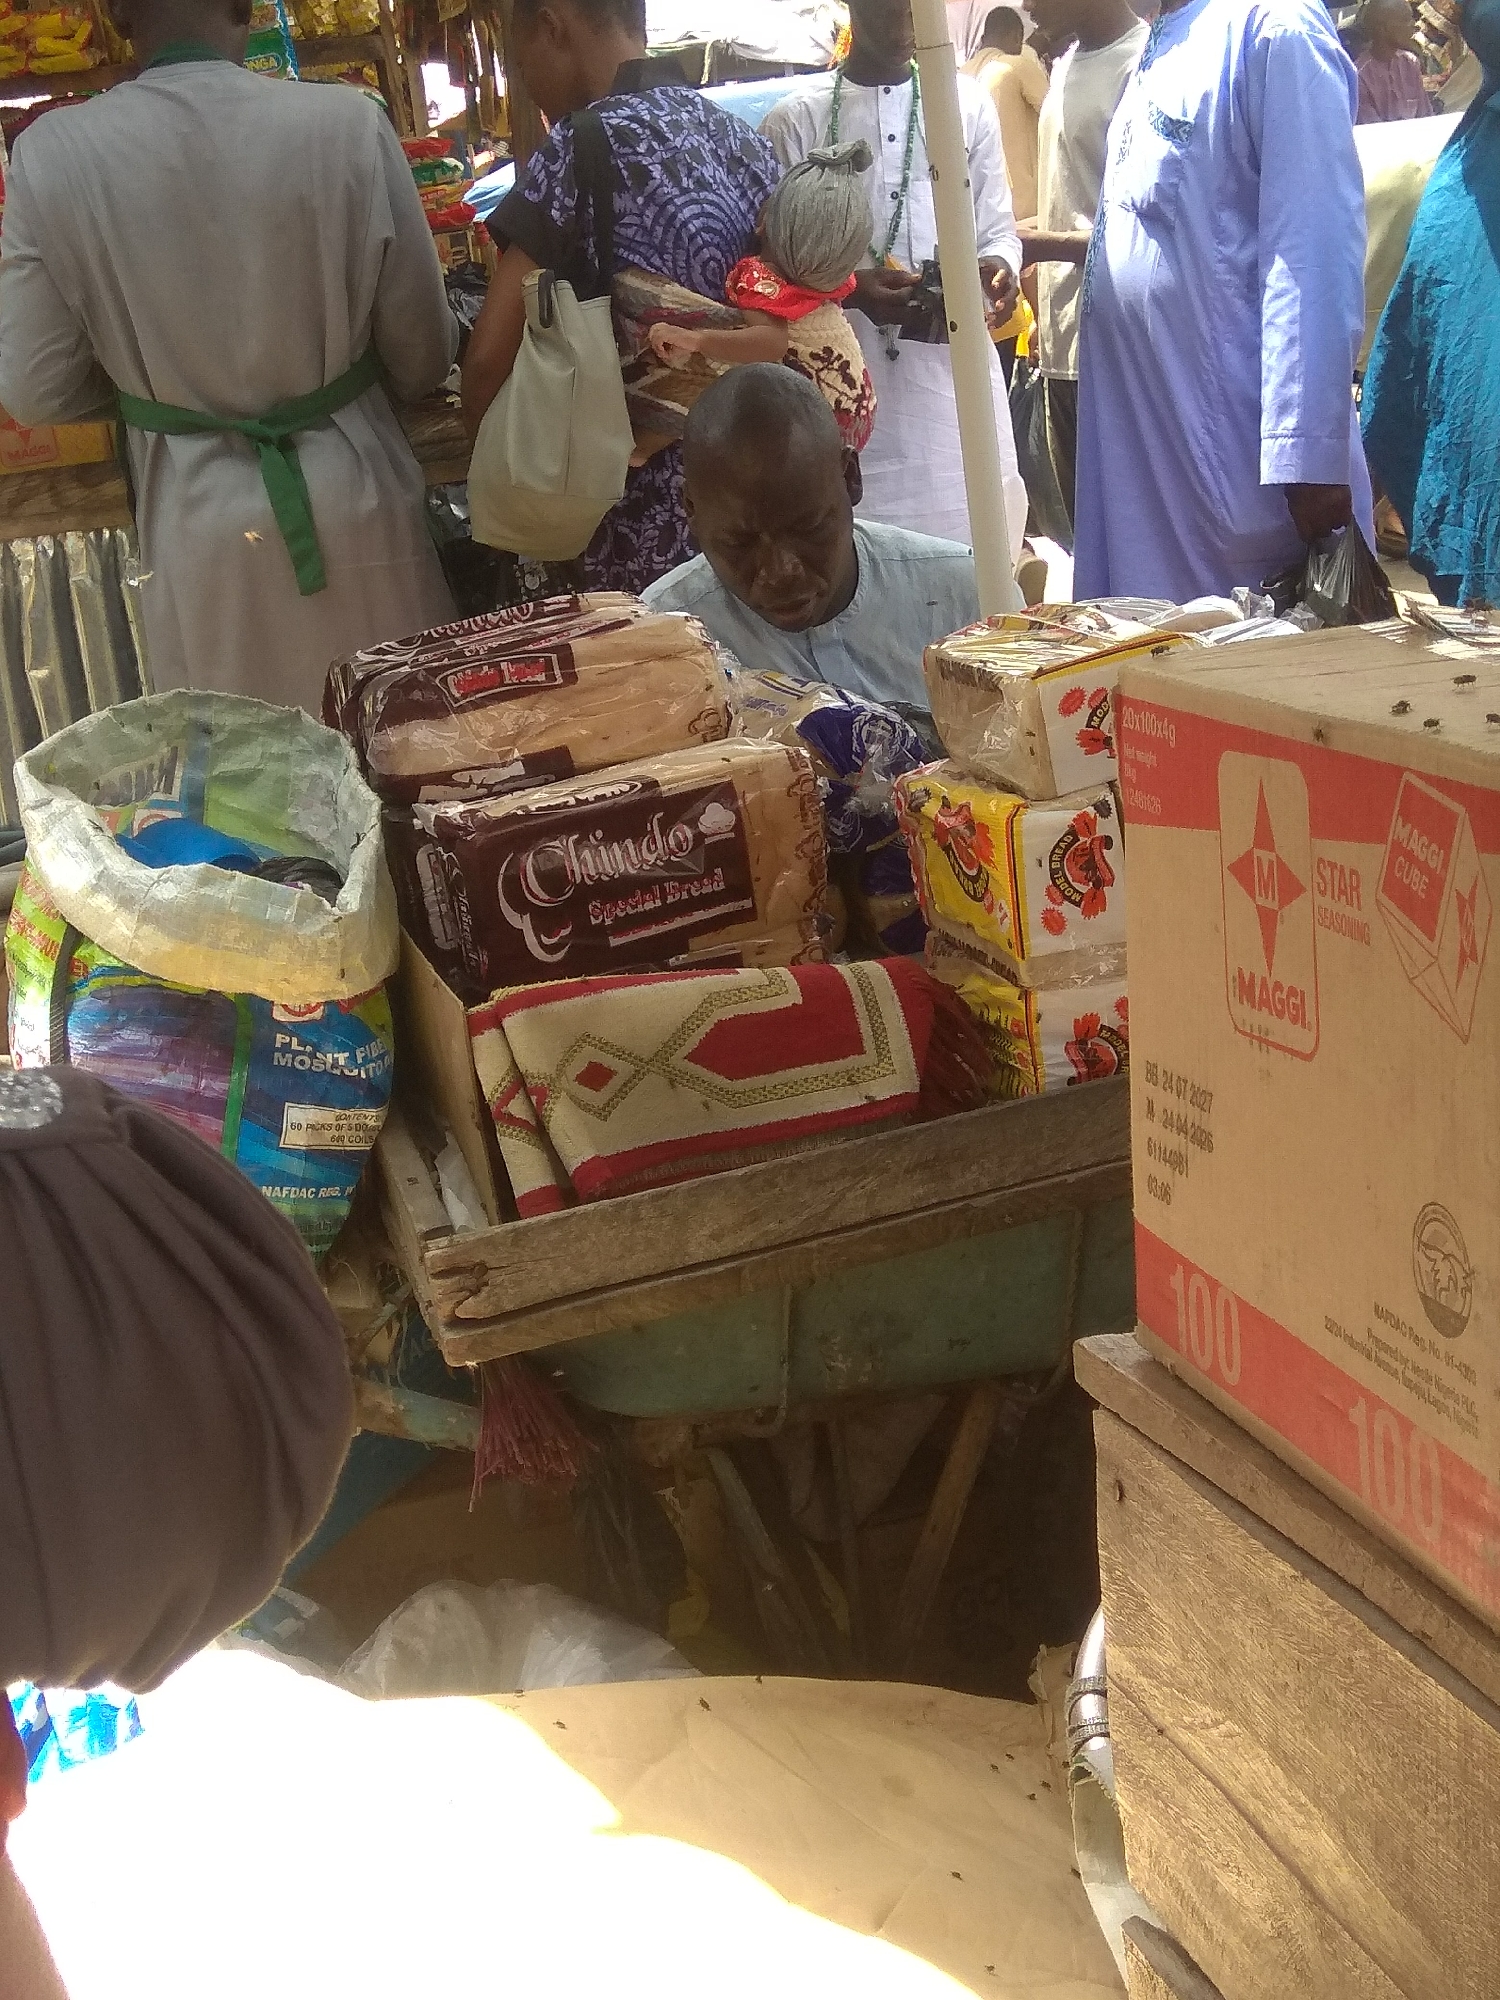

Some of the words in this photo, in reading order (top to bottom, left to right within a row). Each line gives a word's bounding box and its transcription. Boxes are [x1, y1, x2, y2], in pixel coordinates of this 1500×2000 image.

[1122, 705, 1176, 748] 20x100x4g
[519, 811, 694, 907] Chindo
[1051, 834, 1073, 869] BREAD
[1394, 815, 1446, 875] MAGGI
[588, 879, 663, 927] Special
[665, 867, 726, 902] Bread
[1053, 869, 1083, 902] MODEL
[1315, 857, 1362, 912] STAR
[1394, 856, 1430, 900] CUBE
[1317, 904, 1371, 947] SEASONING
[1145, 1060, 1159, 1087] BB
[1162, 1068, 1174, 1094] 24
[1176, 1075, 1189, 1101] 07
[1189, 1081, 1214, 1114] 2027
[290, 1122, 303, 1132] 60
[1162, 1107, 1175, 1133] 24
[261, 1185, 316, 1199] NAFDAC
[1169, 1263, 1242, 1387] 100
[1349, 1395, 1445, 1542] 100
